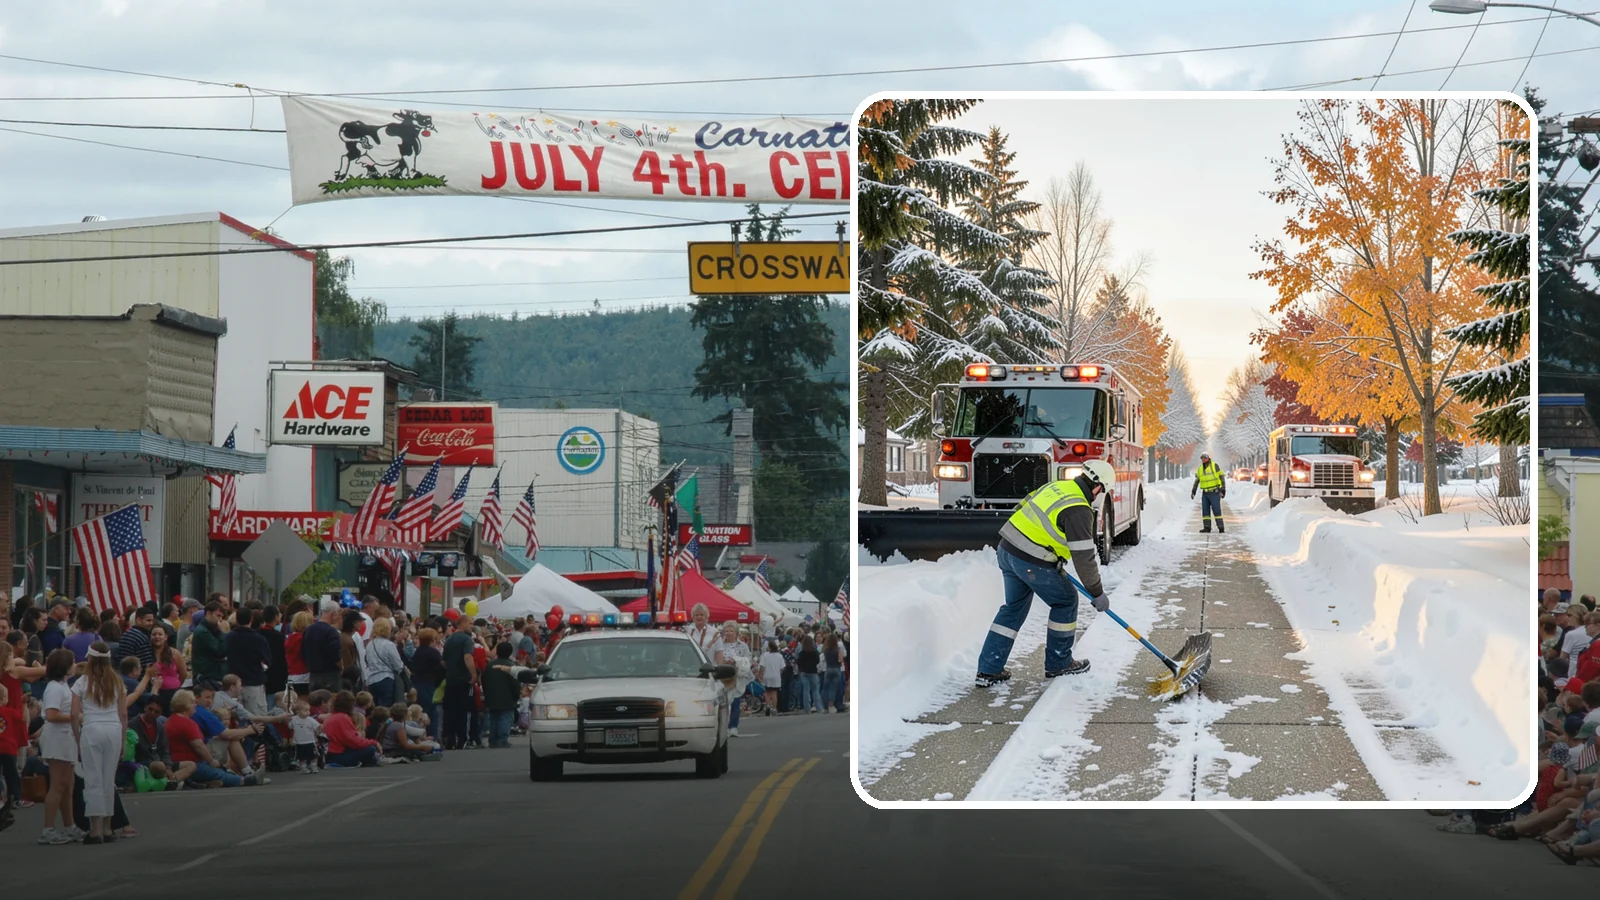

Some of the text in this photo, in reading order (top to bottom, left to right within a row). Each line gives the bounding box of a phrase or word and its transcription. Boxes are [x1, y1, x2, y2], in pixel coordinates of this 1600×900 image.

[481, 140, 605, 192] JULY
[632, 150, 746, 198] 4th.
[697, 254, 850, 280] CROSSWA
[283, 380, 373, 420] ACE
[406, 409, 453, 422] CEDAR
[283, 421, 371, 436] Hardware
[95, 485, 124, 495] Vincent
[126, 485, 136, 495] de
[137, 485, 155, 495] Paul
[688, 526, 741, 535] CRNATION
[699, 535, 730, 543] GLASS
